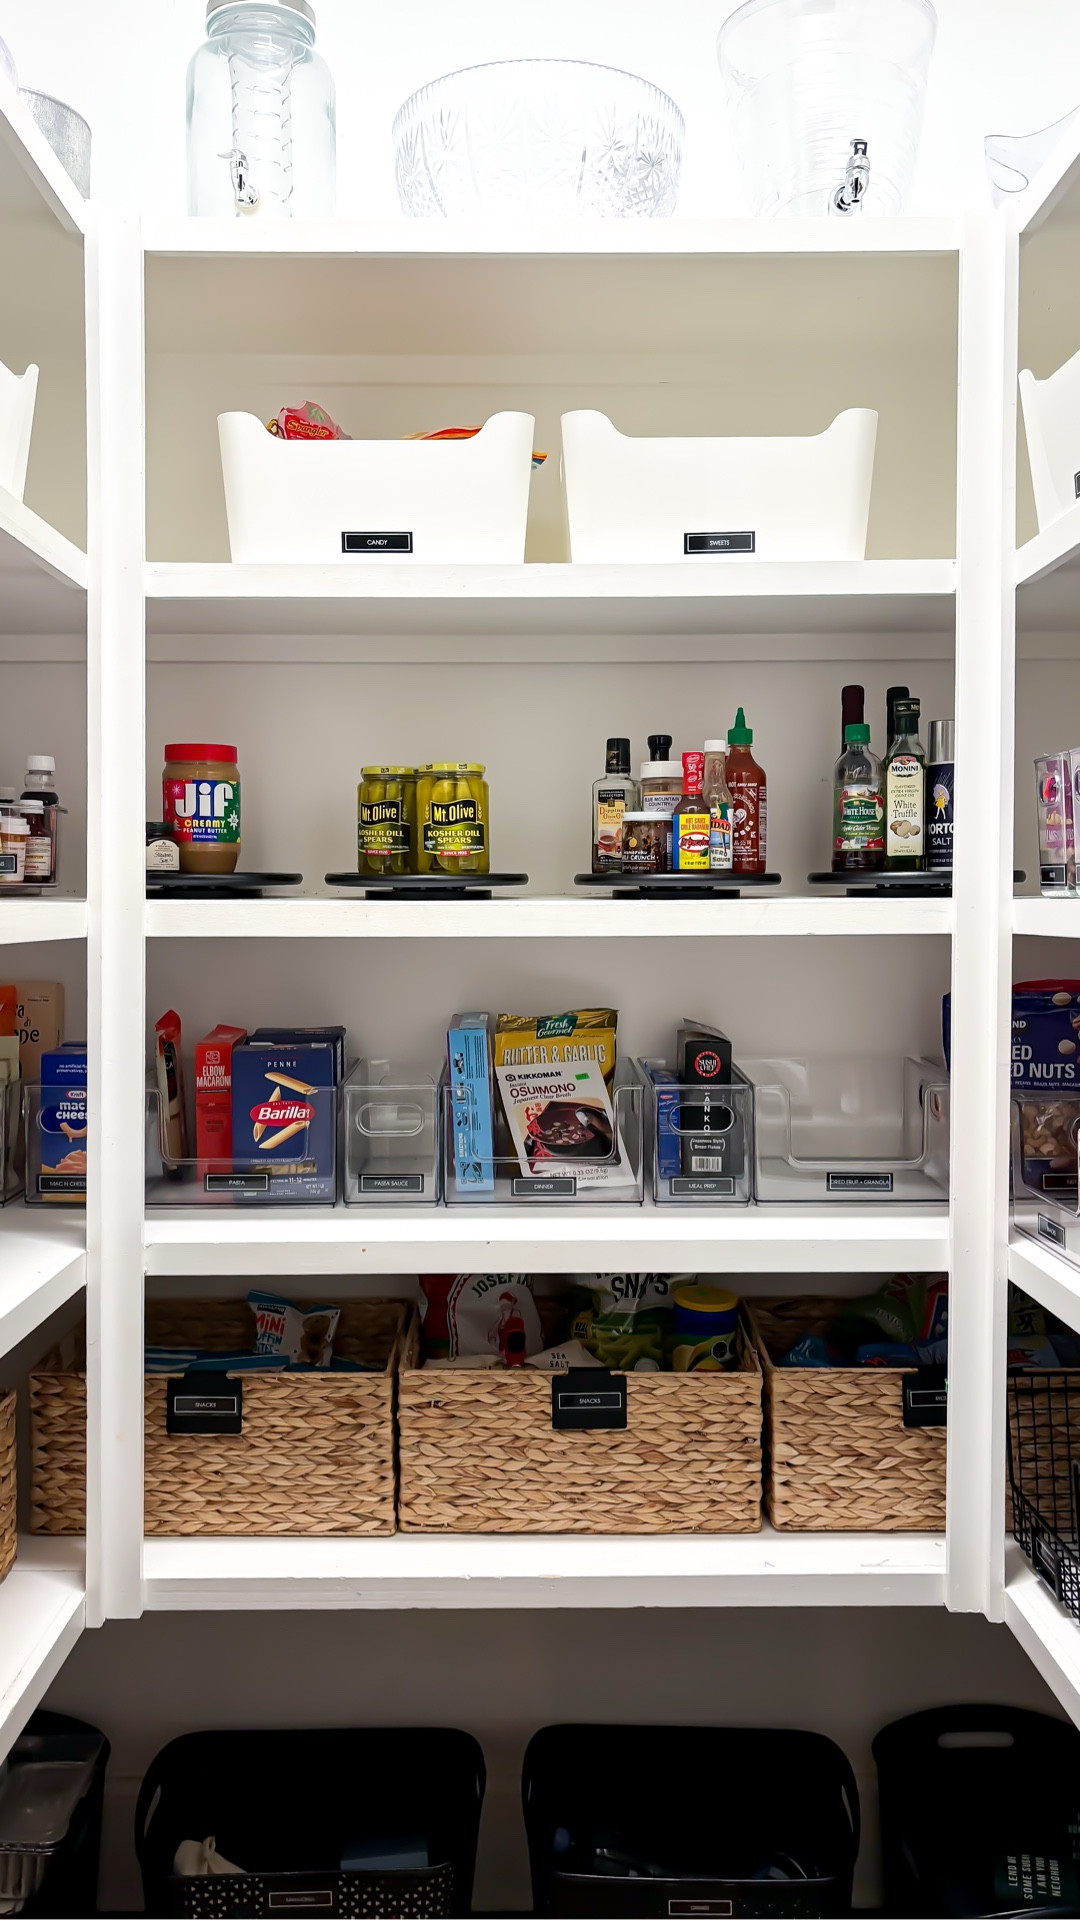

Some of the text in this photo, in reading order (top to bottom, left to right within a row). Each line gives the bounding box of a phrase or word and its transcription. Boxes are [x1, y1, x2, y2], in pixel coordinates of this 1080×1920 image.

[287, 420, 329, 437] Spangler
[175, 783, 233, 817] Jif
[894, 800, 917, 809] White
[362, 805, 397, 822] Mt. Olive
[433, 804, 474, 822] Mt. Olive
[600, 806, 624, 815] Dipping
[859, 807, 876, 815] HOUSE
[893, 809, 918, 818] Truffle
[184, 820, 226, 828] CREAMY
[932, 838, 951, 846] SALT
[545, 1019, 568, 1030] Fresh
[537, 1027, 573, 1038] Gourmet
[503, 1046, 548, 1065] BUTTER
[551, 1046, 560, 1063] &
[563, 1044, 606, 1063] GARLIC
[202, 1066, 225, 1076] ELBOW
[517, 1071, 562, 1080] KIKKOMAN
[1029, 1063, 1075, 1079] NUTS
[197, 1076, 231, 1087] MACARONI
[510, 1082, 576, 1098] OSUIMONO
[60, 1102, 85, 1110] mac
[513, 1096, 538, 1105] Japanese
[258, 1106, 304, 1120] Barilla
[550, 1360, 569, 1368] SALT
[1008, 1865, 1019, 1887] LEND
[1022, 1874, 1034, 1900] SOME
